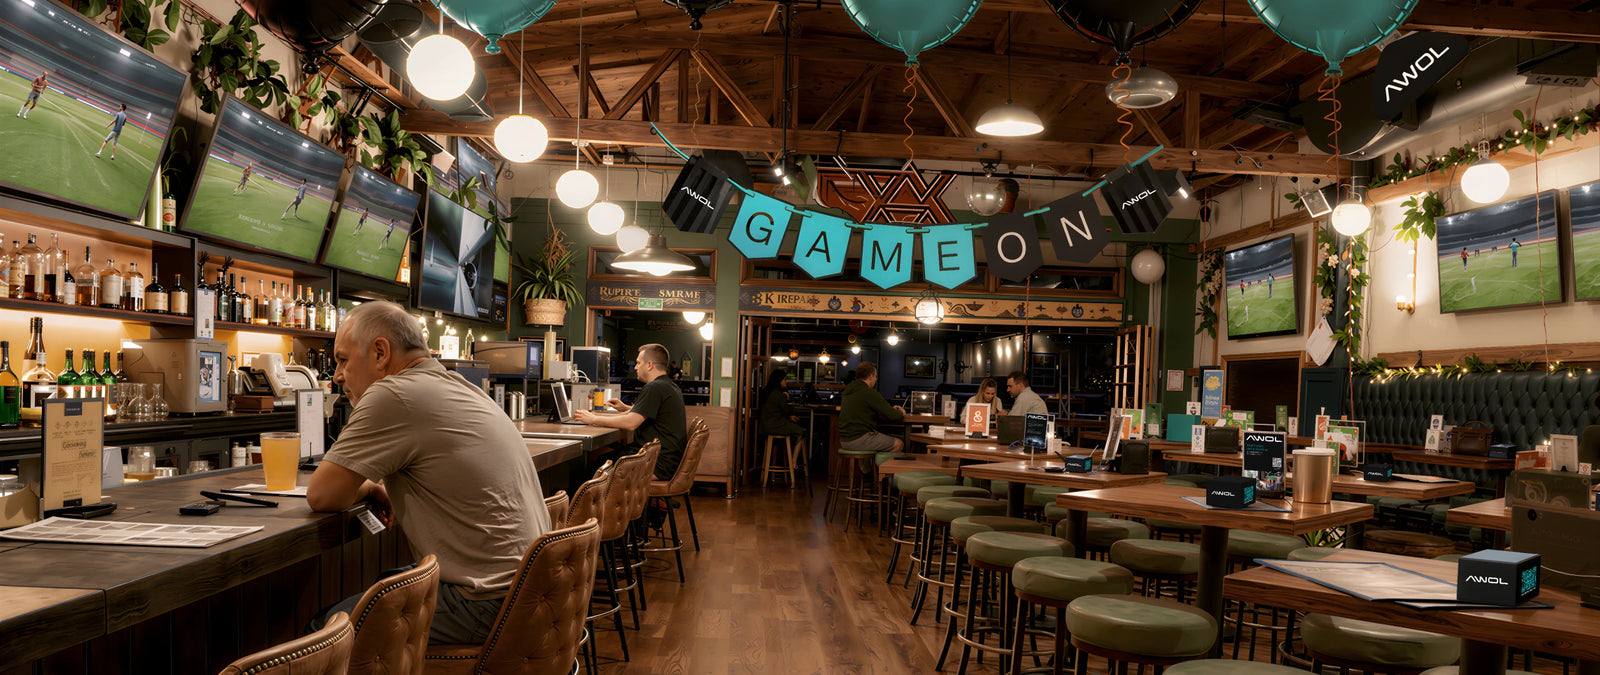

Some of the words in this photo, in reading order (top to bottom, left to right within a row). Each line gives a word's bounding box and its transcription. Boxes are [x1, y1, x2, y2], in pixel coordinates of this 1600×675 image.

[1384, 46, 1450, 103] AWOL
[680, 186, 715, 210] AWOL
[1121, 189, 1157, 210] AWOL
[745, 211, 961, 273] GAME
[997, 210, 1094, 264] ON
[1246, 435, 1283, 443] AWOL
[1465, 575, 1509, 585] AWOL
